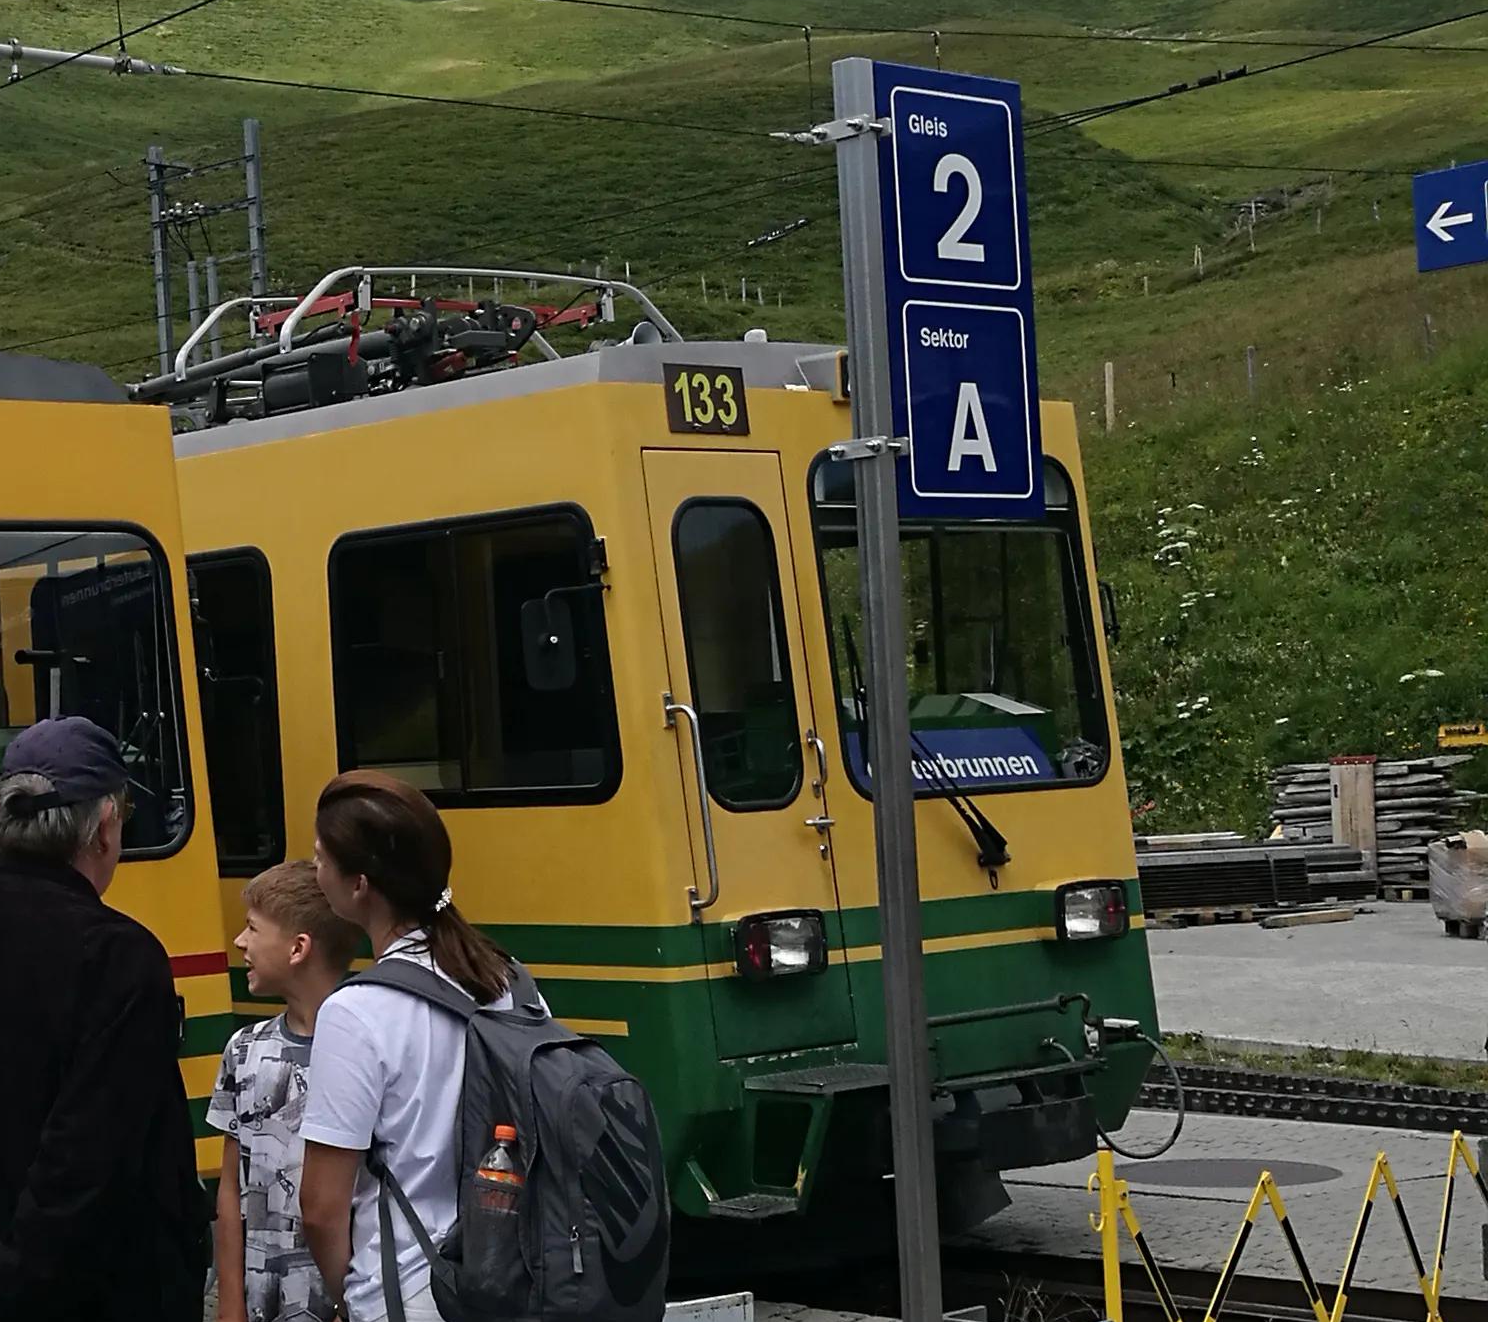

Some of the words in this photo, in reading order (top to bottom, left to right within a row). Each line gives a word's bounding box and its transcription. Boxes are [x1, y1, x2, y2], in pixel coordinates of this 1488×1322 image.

[908, 113, 948, 139] Gleis
[933, 152, 985, 263] 2
[920, 326, 969, 349] Sektor
[674, 372, 738, 425] 133
[947, 381, 997, 473] A
